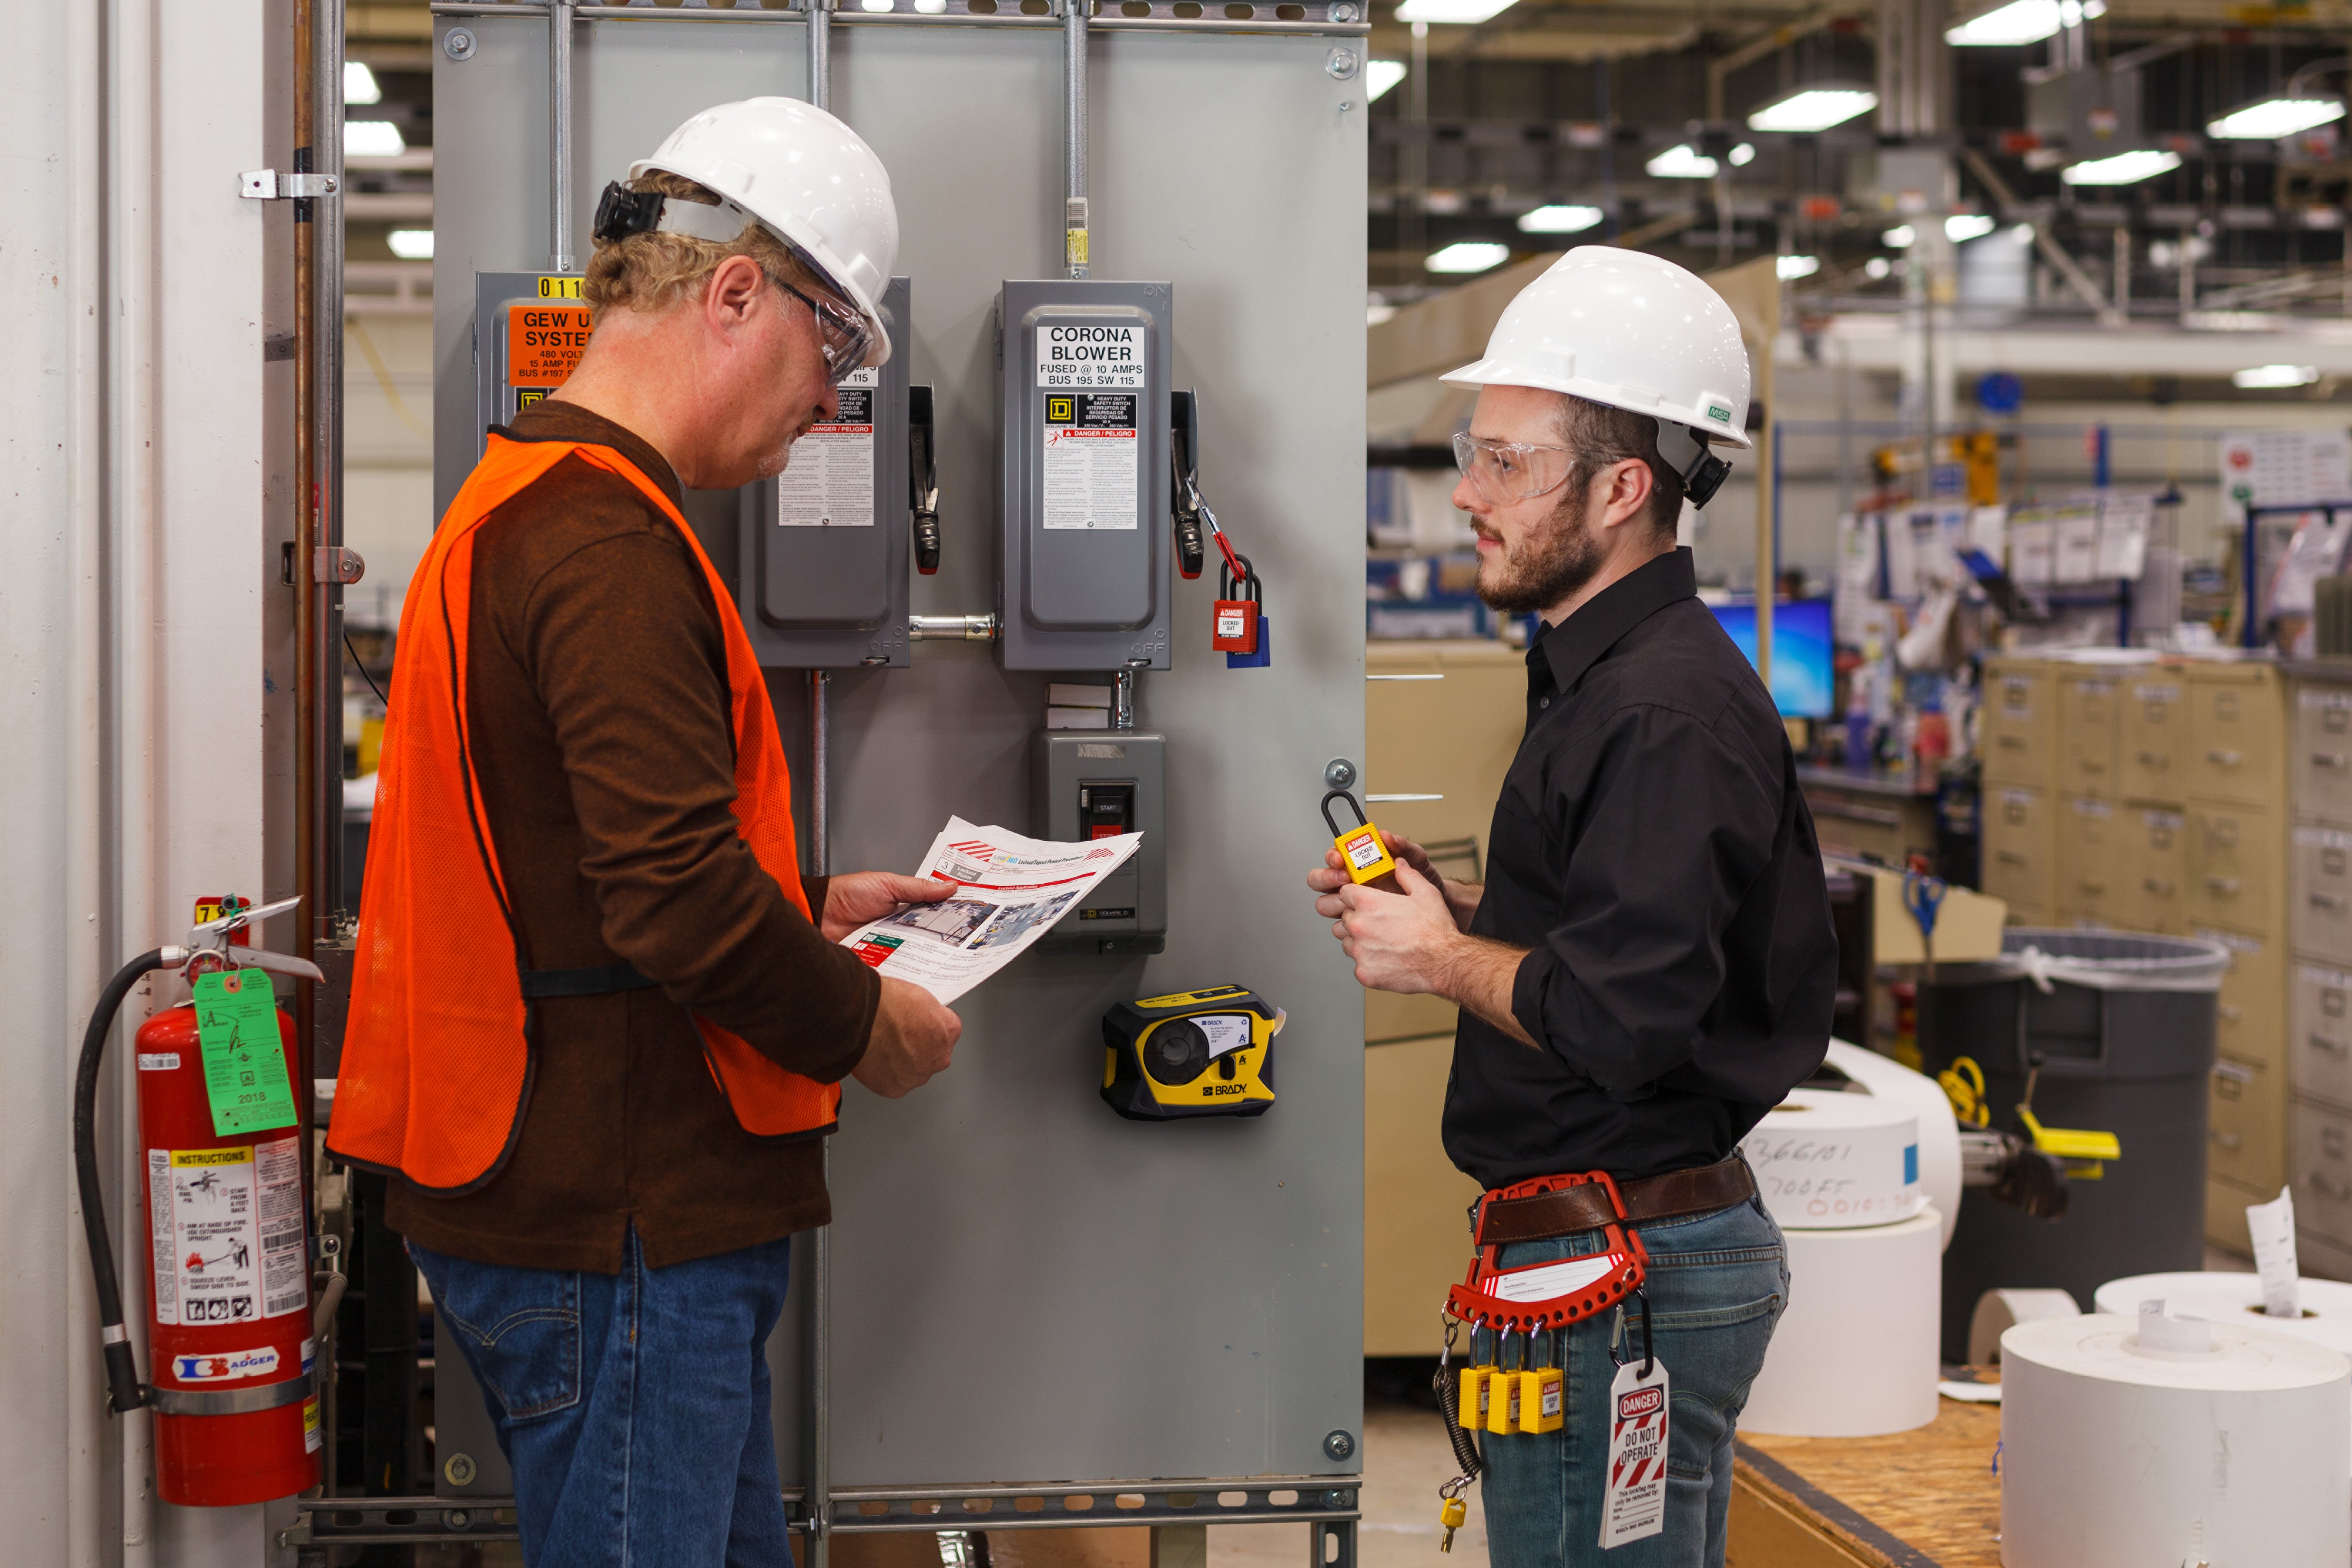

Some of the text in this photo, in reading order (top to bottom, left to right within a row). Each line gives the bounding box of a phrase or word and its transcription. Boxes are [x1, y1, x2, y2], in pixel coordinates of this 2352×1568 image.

[1144, 286, 1166, 297] ON
[524, 312, 590, 328] GEW U
[526, 331, 593, 346] SYSTE
[1051, 328, 1132, 342] CORONA
[1052, 346, 1131, 361] BLOWER
[1040, 364, 1142, 374] FUSED @ 10 AMPS
[853, 374, 868, 382] 115
[1049, 376, 1071, 384] BUS
[1076, 376, 1093, 384] 195
[1098, 376, 1114, 384] SW
[1710, 407, 1728, 421] MSA
[871, 641, 903, 652] OFF
[1132, 643, 1165, 653] OFF
[1351, 834, 1371, 848] DANGER
[1355, 846, 1373, 858] LOCKED
[957, 866, 977, 877] Lockout
[237, 1092, 266, 1104] 2018
[177, 1151, 245, 1165] INSTRUCTIONS
[1547, 1382, 1559, 1392] DANGER
[1623, 1393, 1658, 1414] DANGER
[1626, 1426, 1656, 1447] DO NOT
[1621, 1442, 1658, 1465] OPERATE
[1629, 1486, 1646, 1495] lock/tag
[1632, 1491, 1651, 1501] removed
